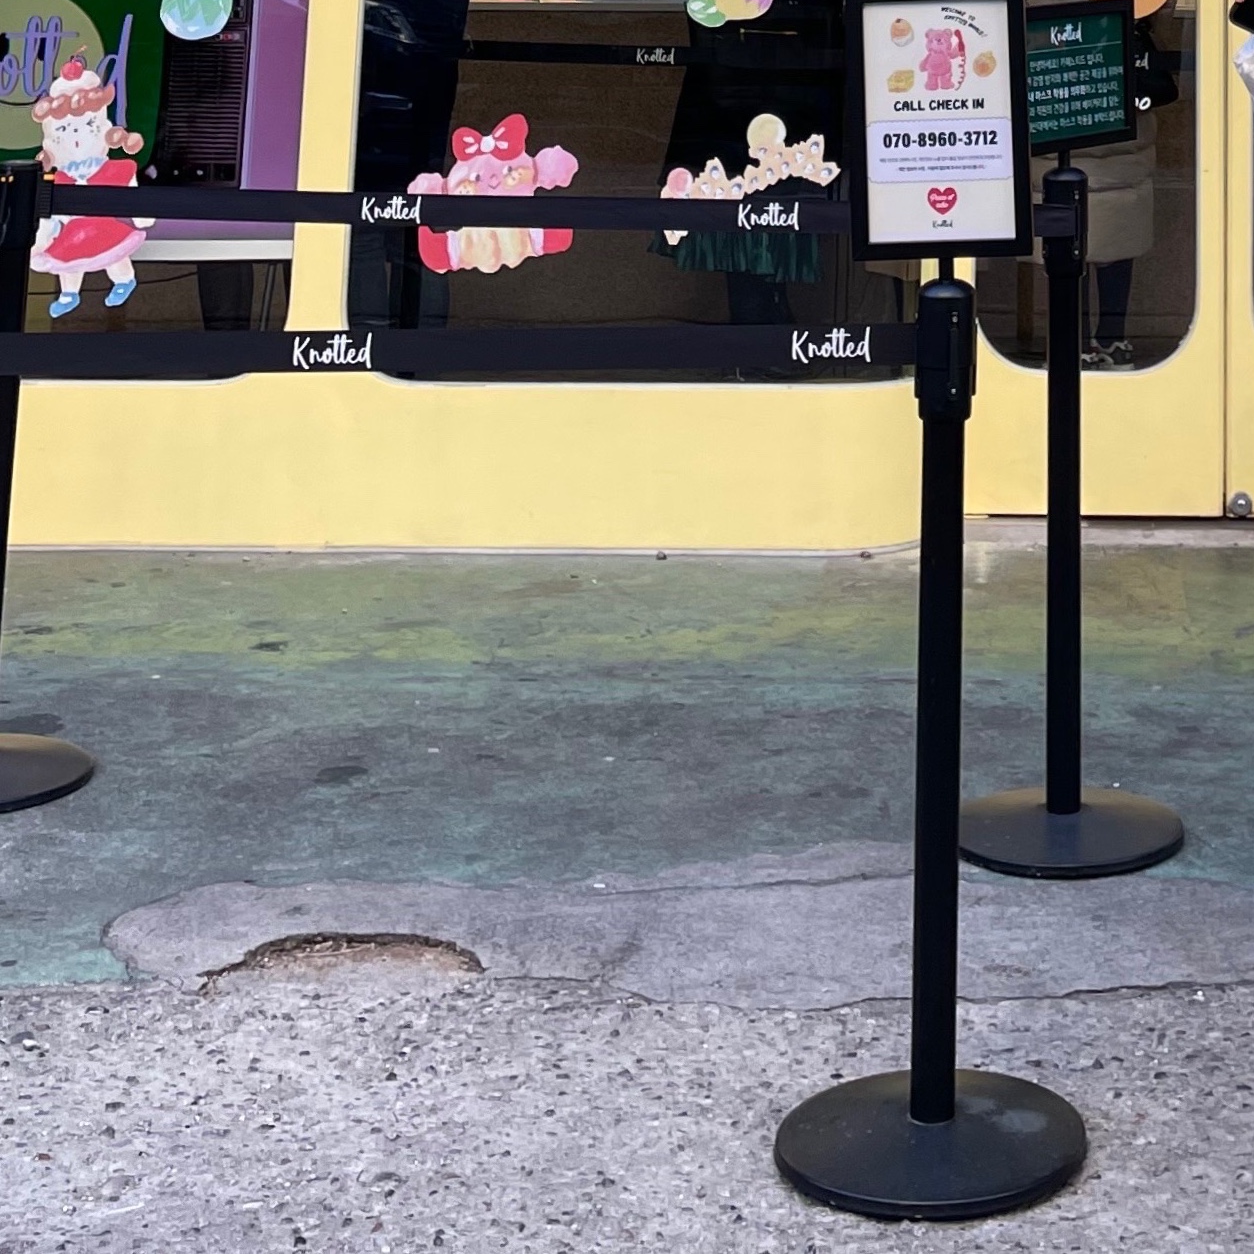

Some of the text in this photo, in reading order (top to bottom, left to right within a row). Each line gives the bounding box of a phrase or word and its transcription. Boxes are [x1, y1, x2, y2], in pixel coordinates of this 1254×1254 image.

[1050, 22, 1082, 45] Knotted
[636, 47, 675, 65] Knotted
[0, 13, 134, 128] ottd
[894, 98, 985, 112] CALL CHECK IN
[1035, 89, 1052, 101] 마스크
[883, 130, 998, 148] 070-8960-3712
[361, 196, 422, 224] Knotted
[738, 201, 799, 230] Knotted
[292, 332, 372, 370] Knotted
[791, 326, 871, 364] Knotted
